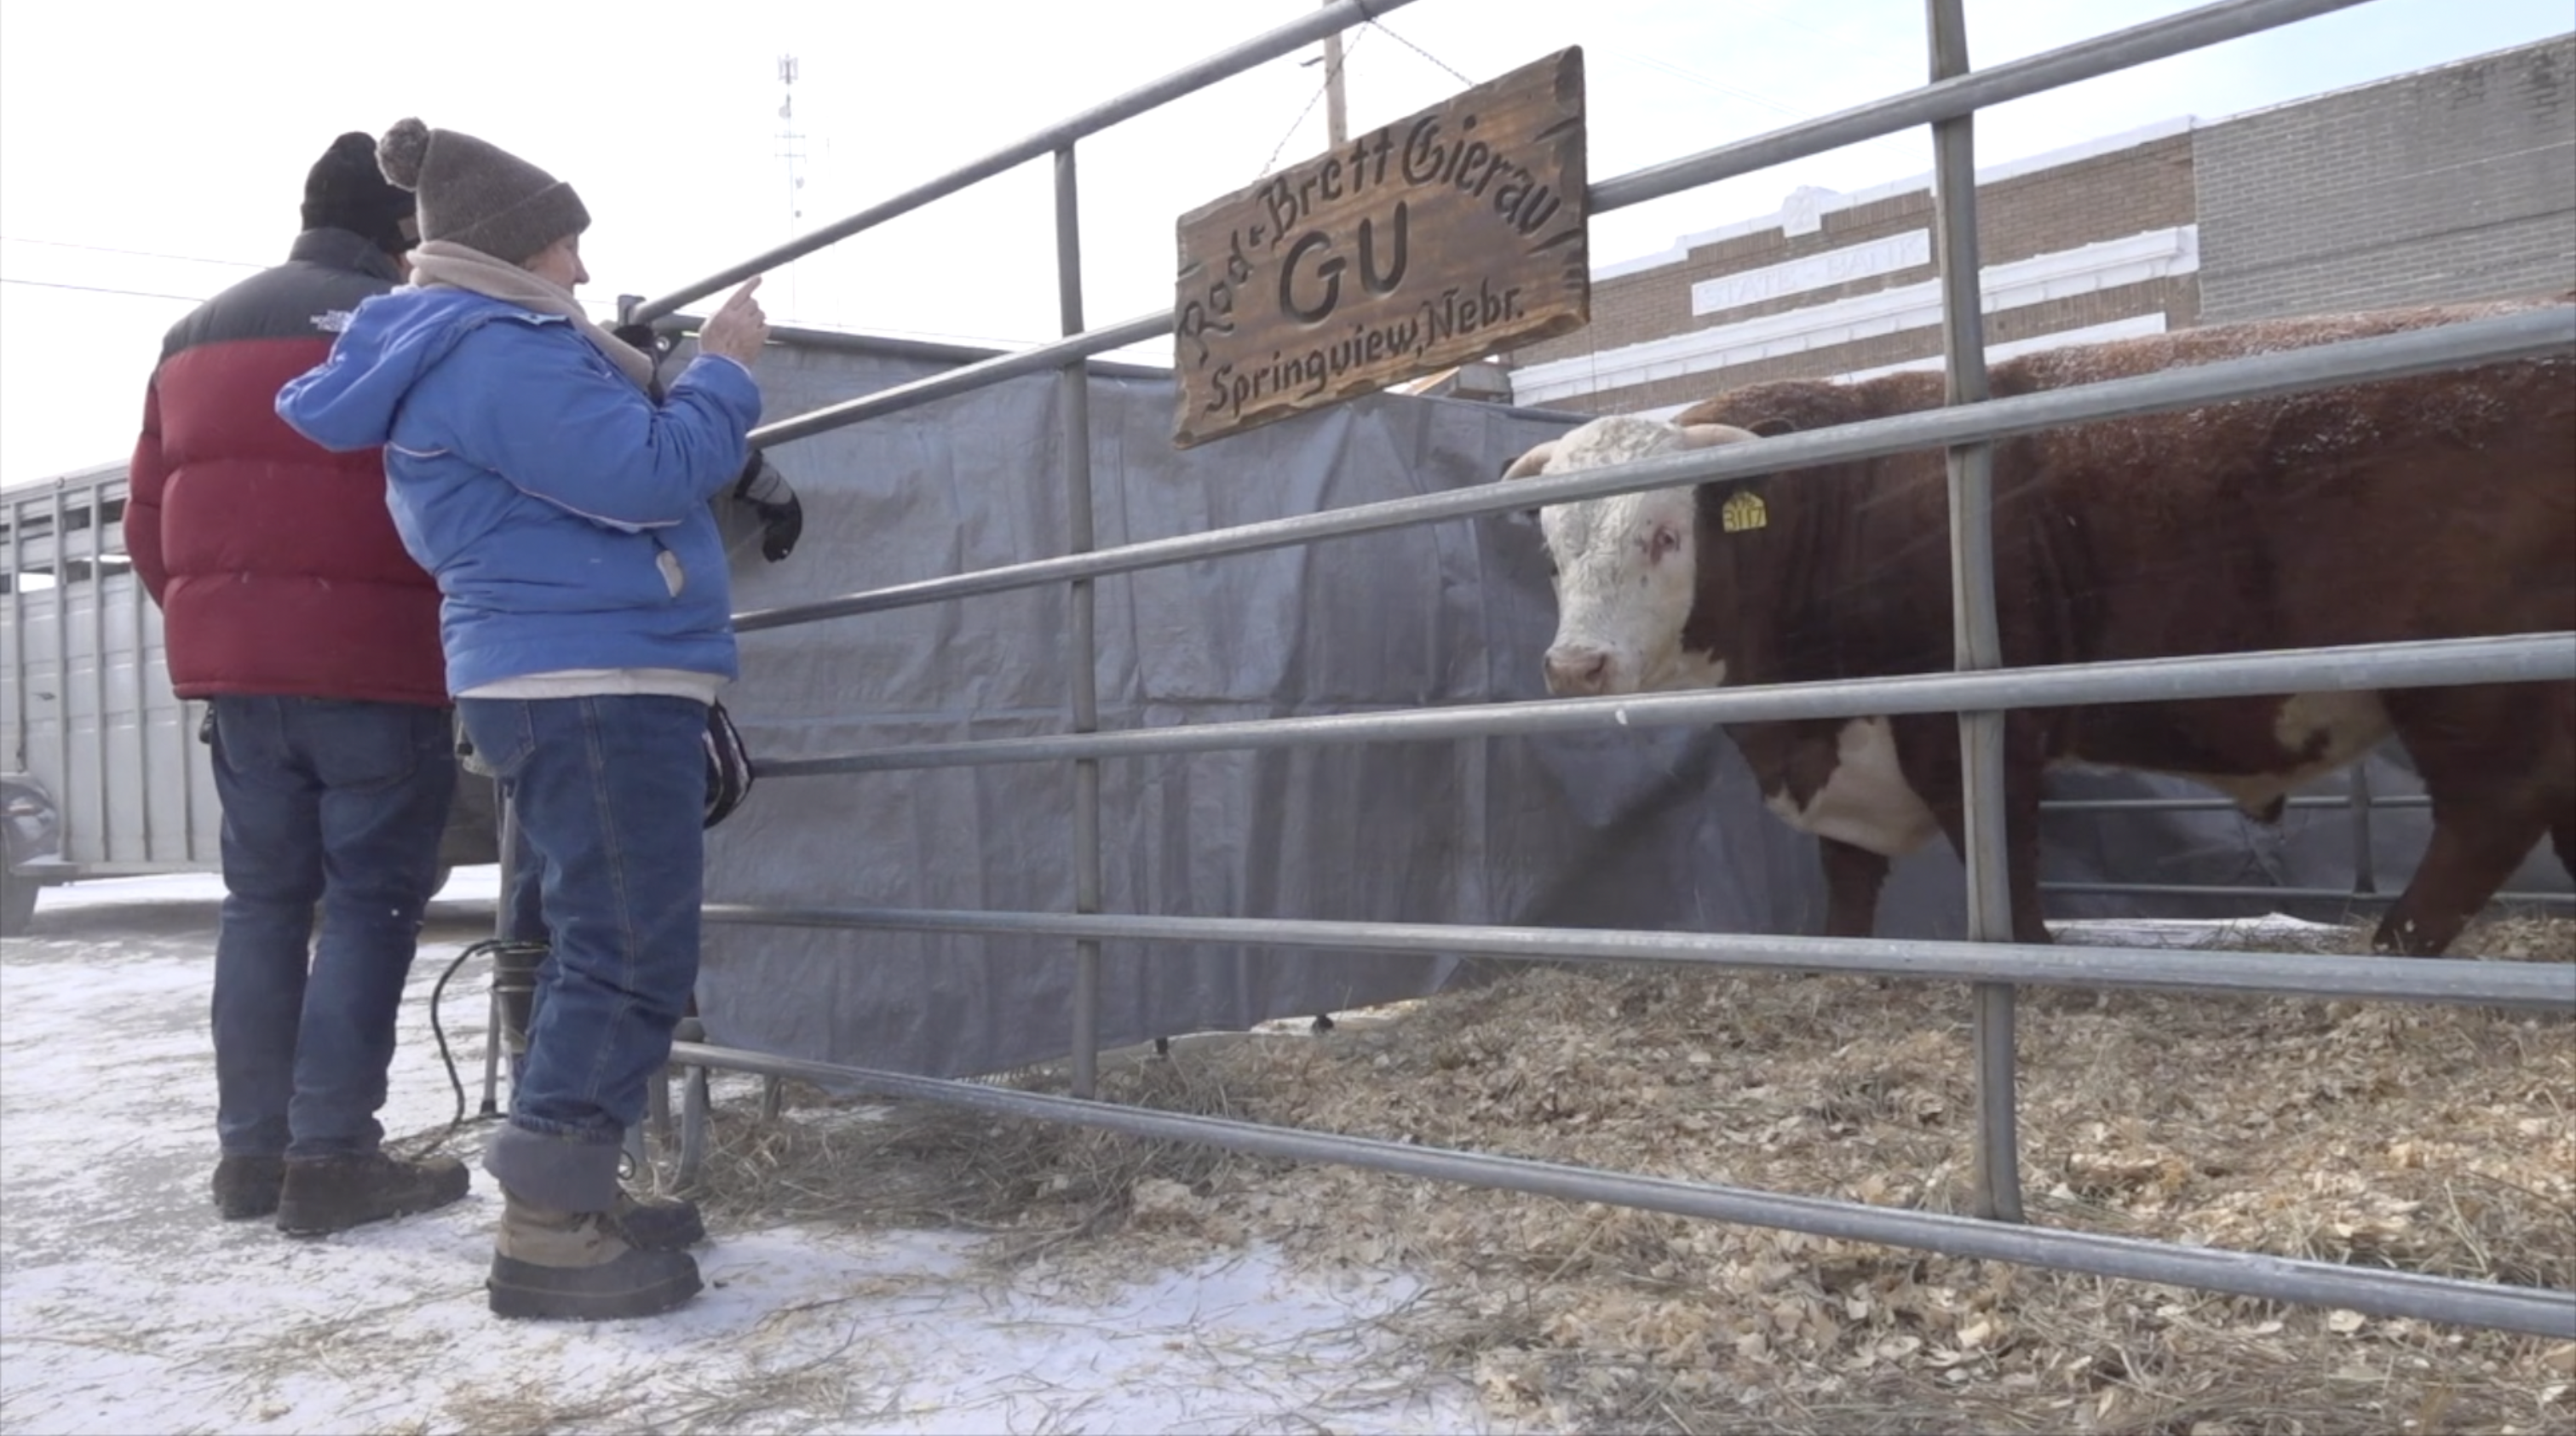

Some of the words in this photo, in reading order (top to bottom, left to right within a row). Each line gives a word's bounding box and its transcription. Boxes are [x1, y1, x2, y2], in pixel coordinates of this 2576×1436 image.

[1177, 228, 1254, 369] Rod
[1256, 127, 1394, 250] Brett
[1402, 114, 1560, 235] Gierau
[1279, 200, 1408, 324] GU
